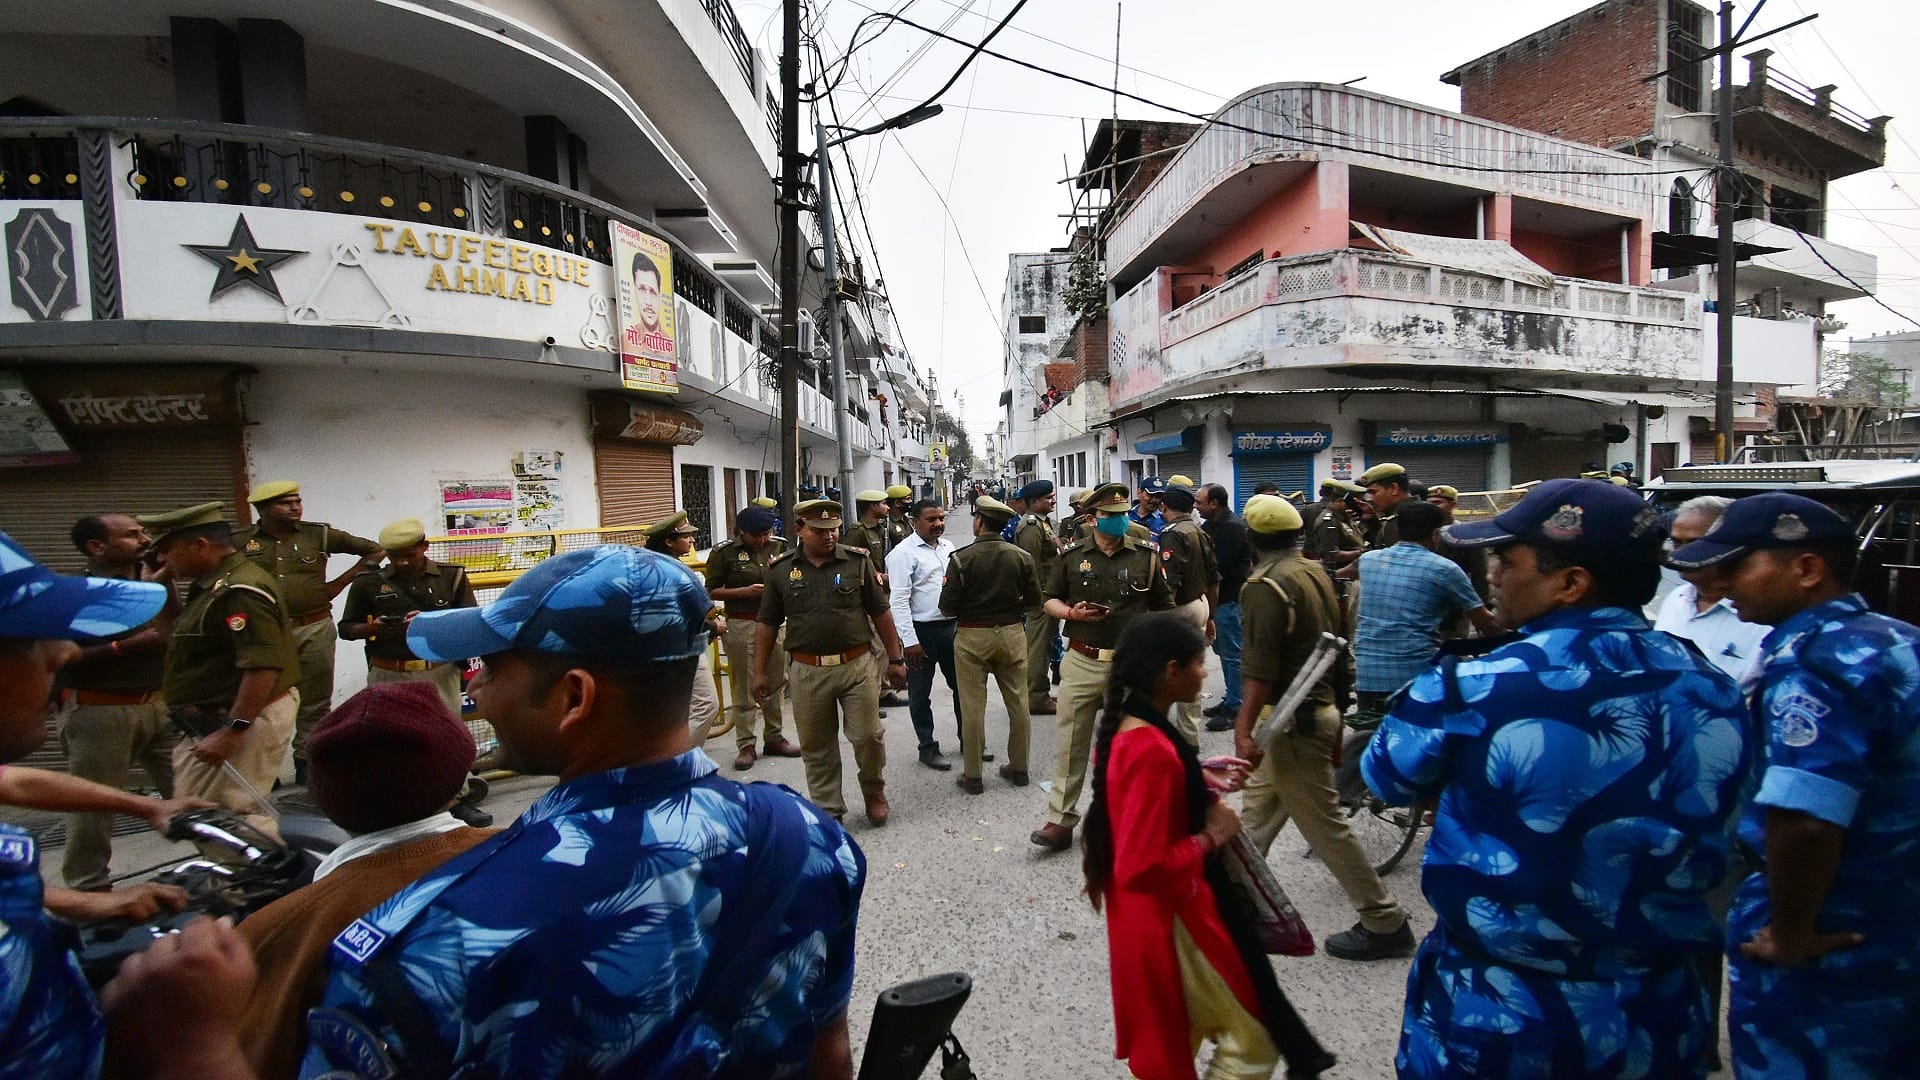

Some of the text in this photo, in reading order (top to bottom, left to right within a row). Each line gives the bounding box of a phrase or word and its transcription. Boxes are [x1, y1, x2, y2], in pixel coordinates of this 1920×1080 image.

[365, 222, 592, 288] TAUFEEQUE
[425, 263, 554, 306] AHMAD
[644, 331, 674, 353] वासिक
[1275, 431, 1328, 450] स्टेशनरी
